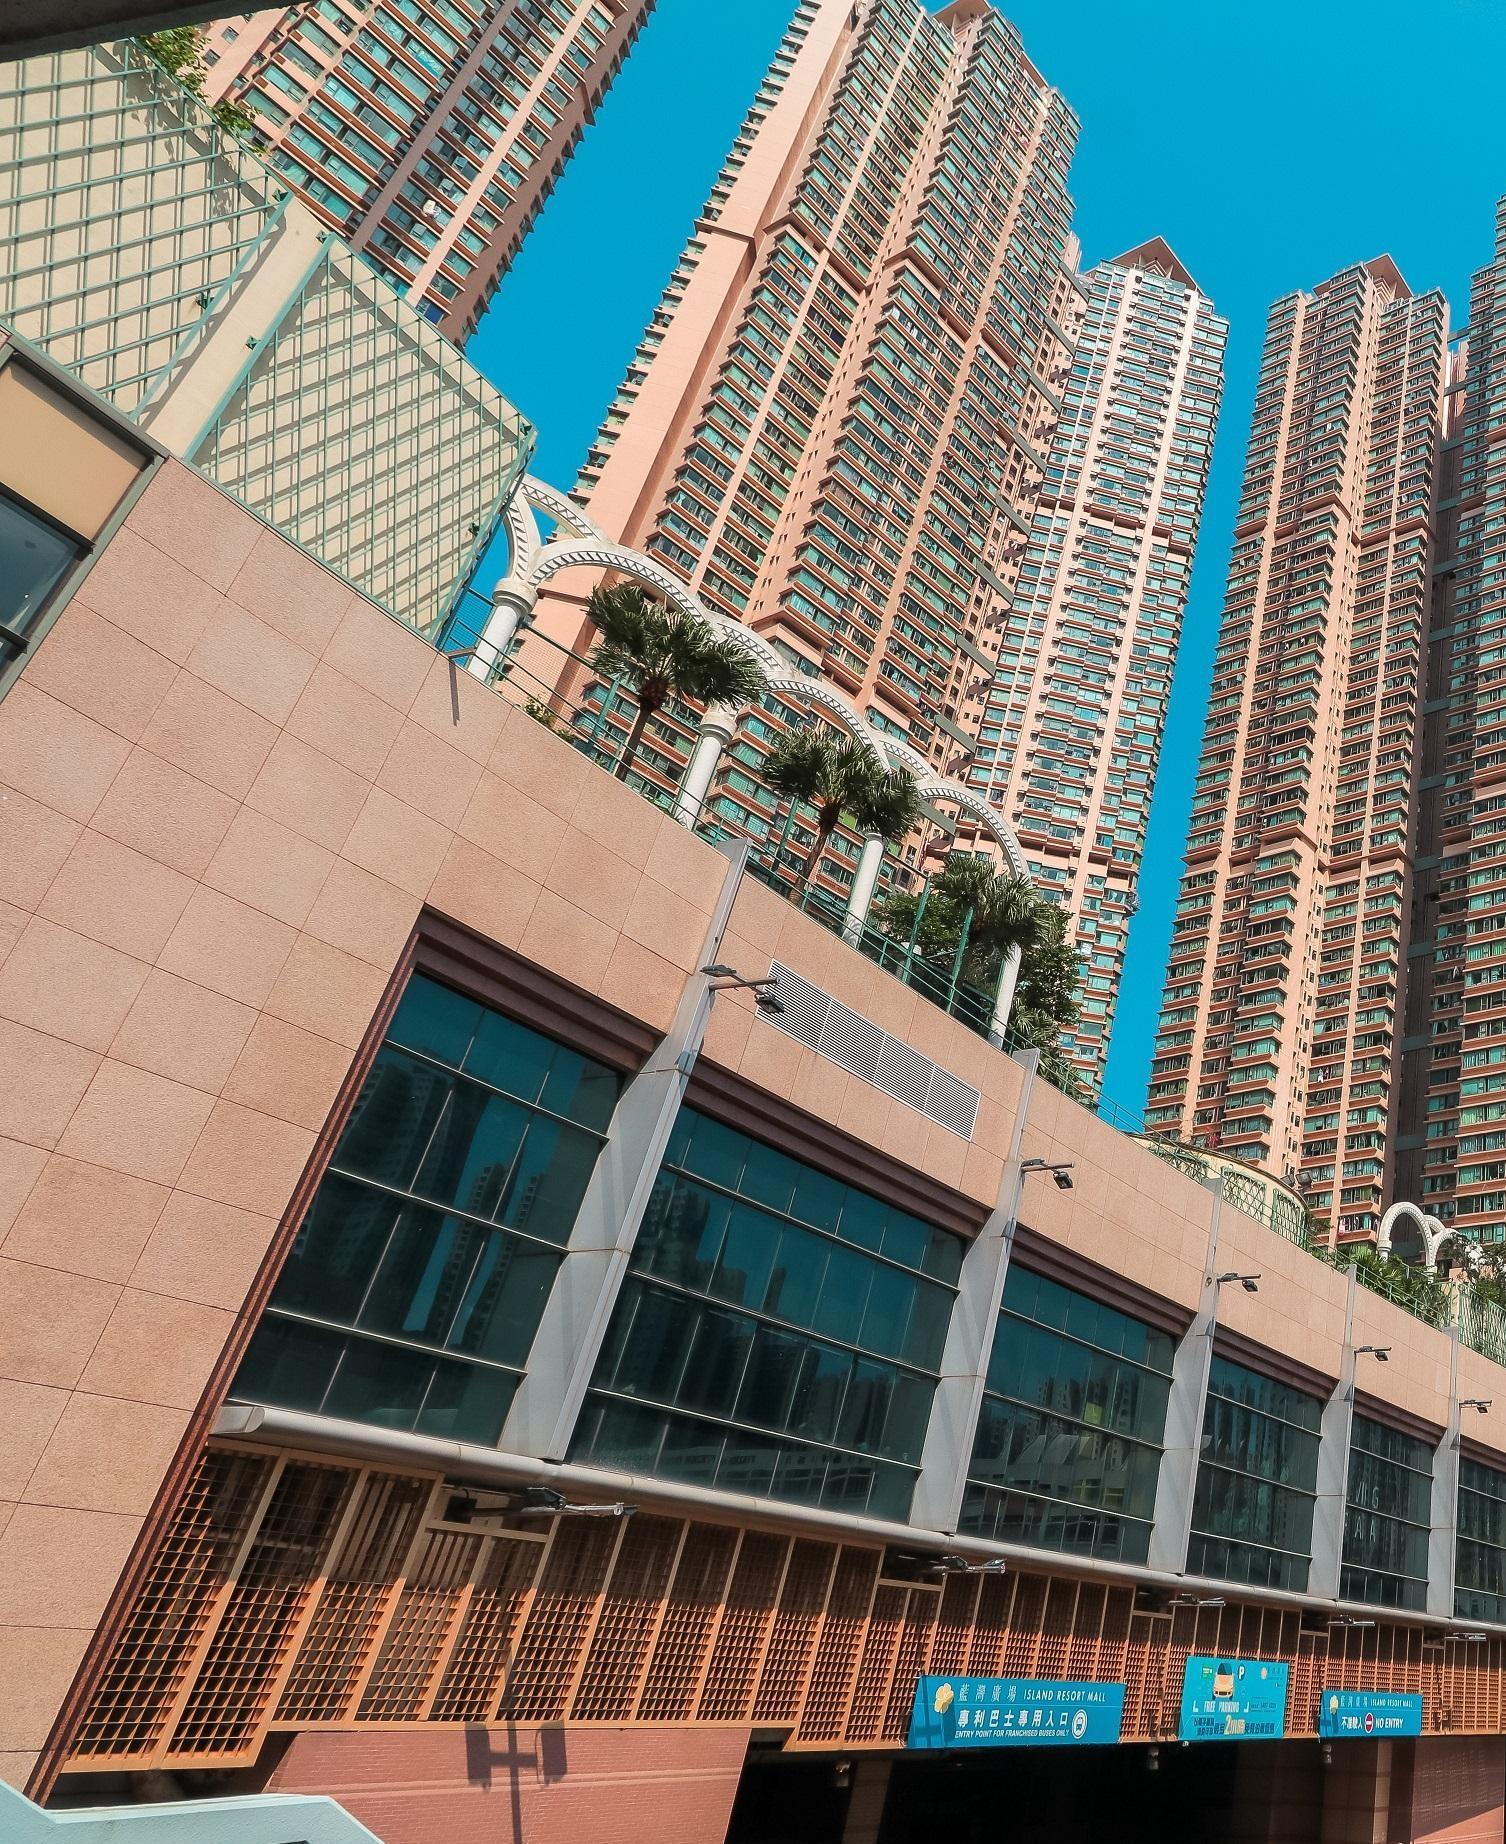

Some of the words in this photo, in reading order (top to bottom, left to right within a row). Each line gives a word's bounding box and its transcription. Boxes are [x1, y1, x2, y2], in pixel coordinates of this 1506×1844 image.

[958, 1683, 1017, 1702] 藍灣廣場
[1024, 1689, 1053, 1701] ISLAND
[1056, 1690, 1085, 1701] RESORT
[1087, 1691, 1106, 1702] MALL
[1203, 1700, 1216, 1713] FREE
[1218, 1701, 1240, 1713] PARKING
[1370, 1698, 1386, 1707] ISLAND
[1402, 1699, 1413, 1708] MALL
[957, 1709, 1069, 1728] 專利巴士專用入口
[1375, 1718, 1383, 1728] NO
[1384, 1717, 1404, 1729] ENTRY
[954, 1730, 974, 1739] ENTRY
[975, 1729, 992, 1738] POINT
[992, 1729, 1004, 1738] FOR
[1004, 1729, 1037, 1738] FRANCHISED
[1038, 1729, 1055, 1737] BUSES
[1055, 1729, 1070, 1737] ONLY
